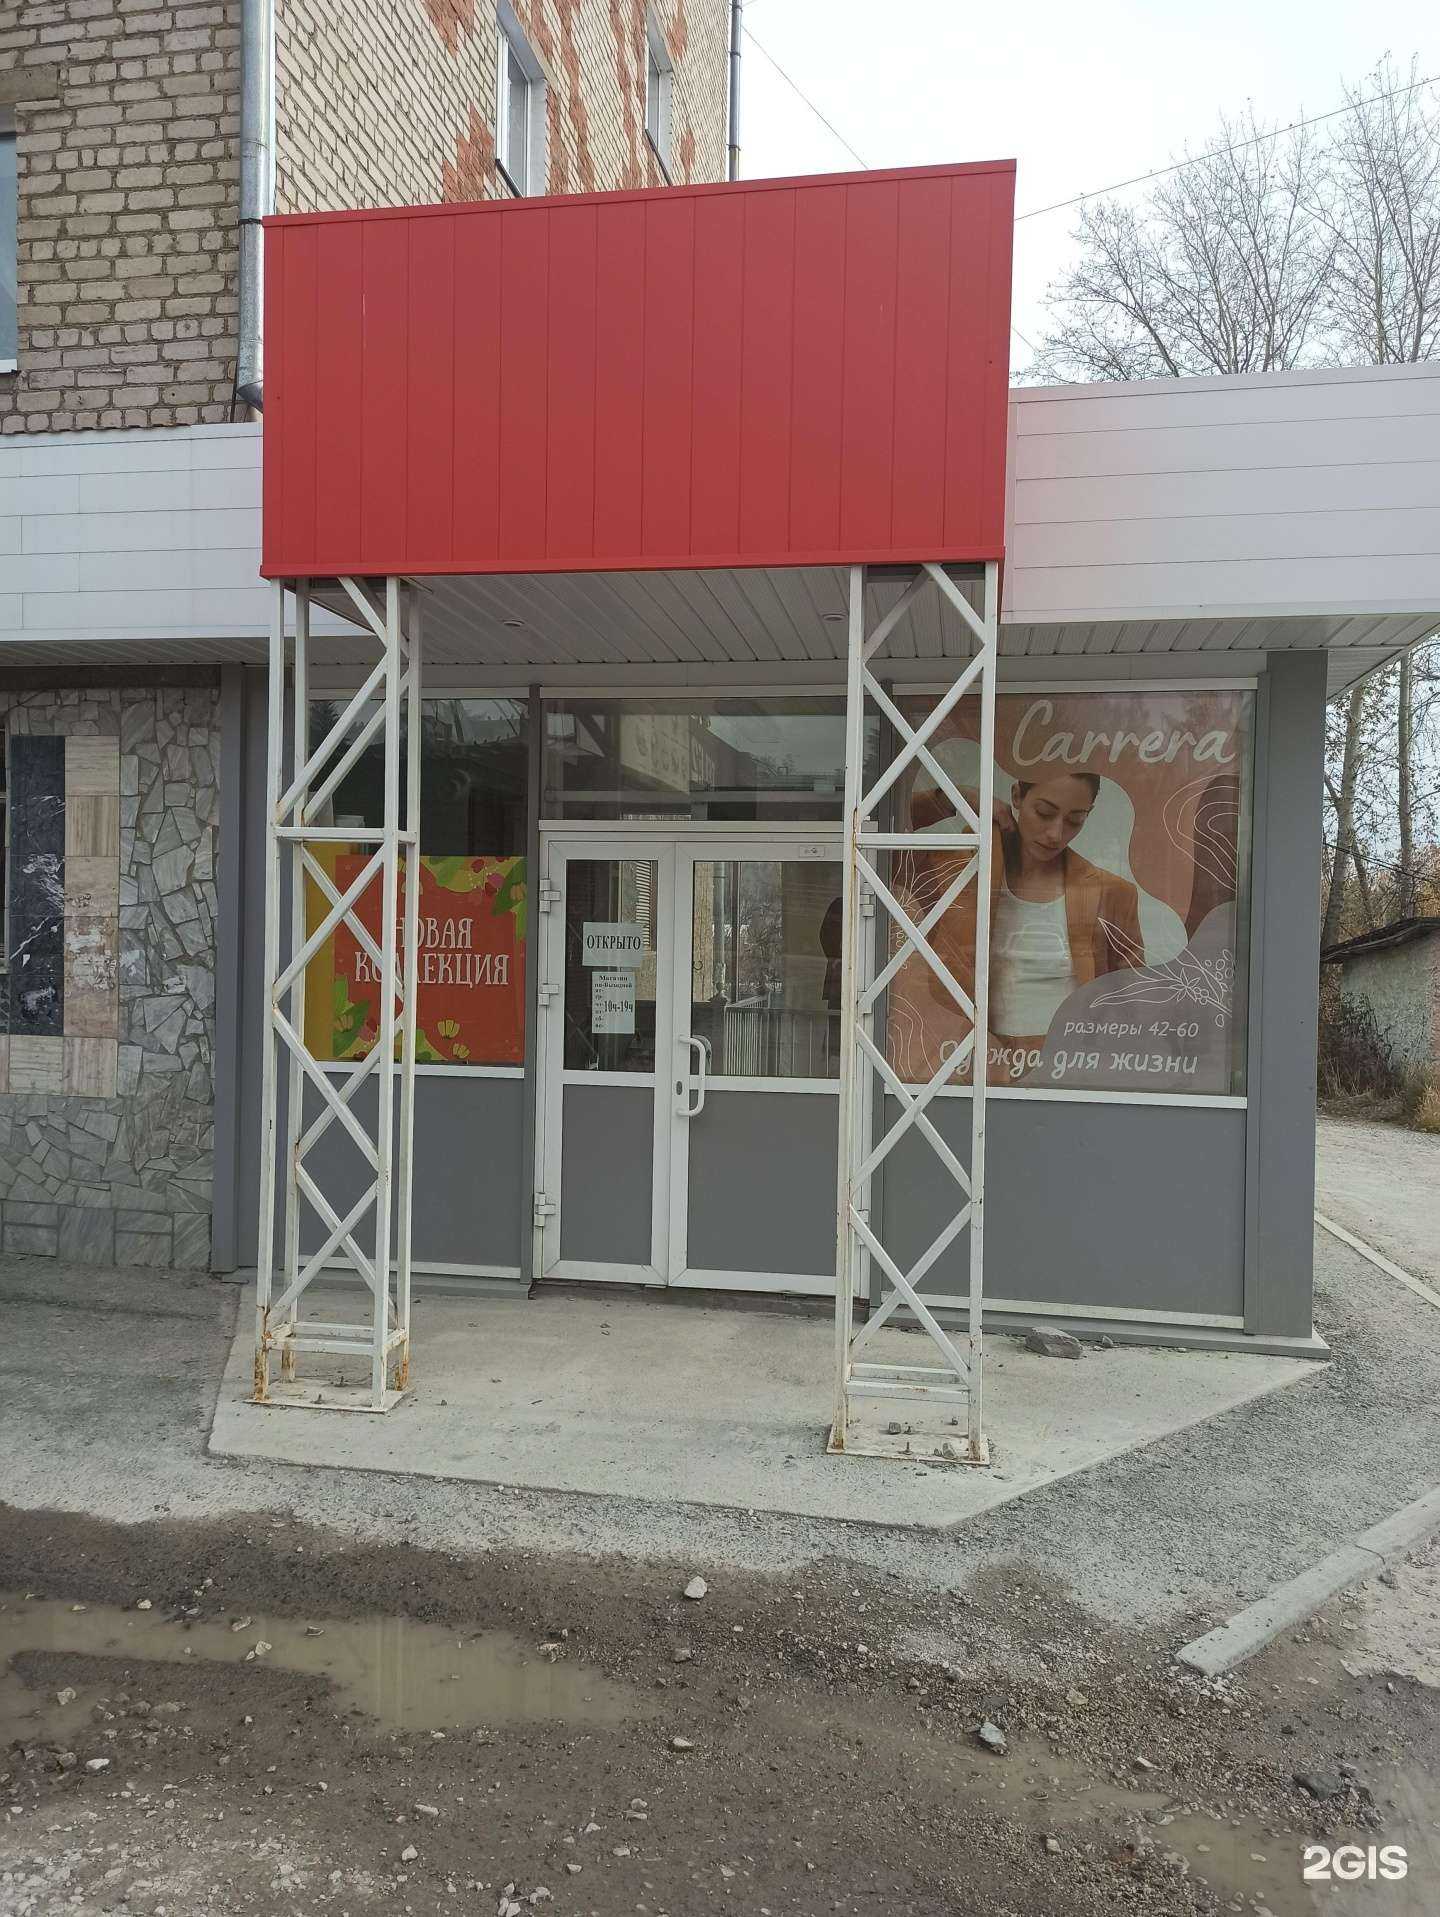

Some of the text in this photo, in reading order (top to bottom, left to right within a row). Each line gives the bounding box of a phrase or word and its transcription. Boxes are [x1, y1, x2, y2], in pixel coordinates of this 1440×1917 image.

[1012, 699, 1236, 767] Carrera
[586, 934, 641, 950] ОТКРЫТО
[354, 951, 510, 989] КЕКЦИЯ
[604, 1000, 633, 1013] 10ч-19ч
[1063, 1020, 1199, 1038] размеры 42-60
[939, 1040, 1199, 1079] Оджда для жизни
